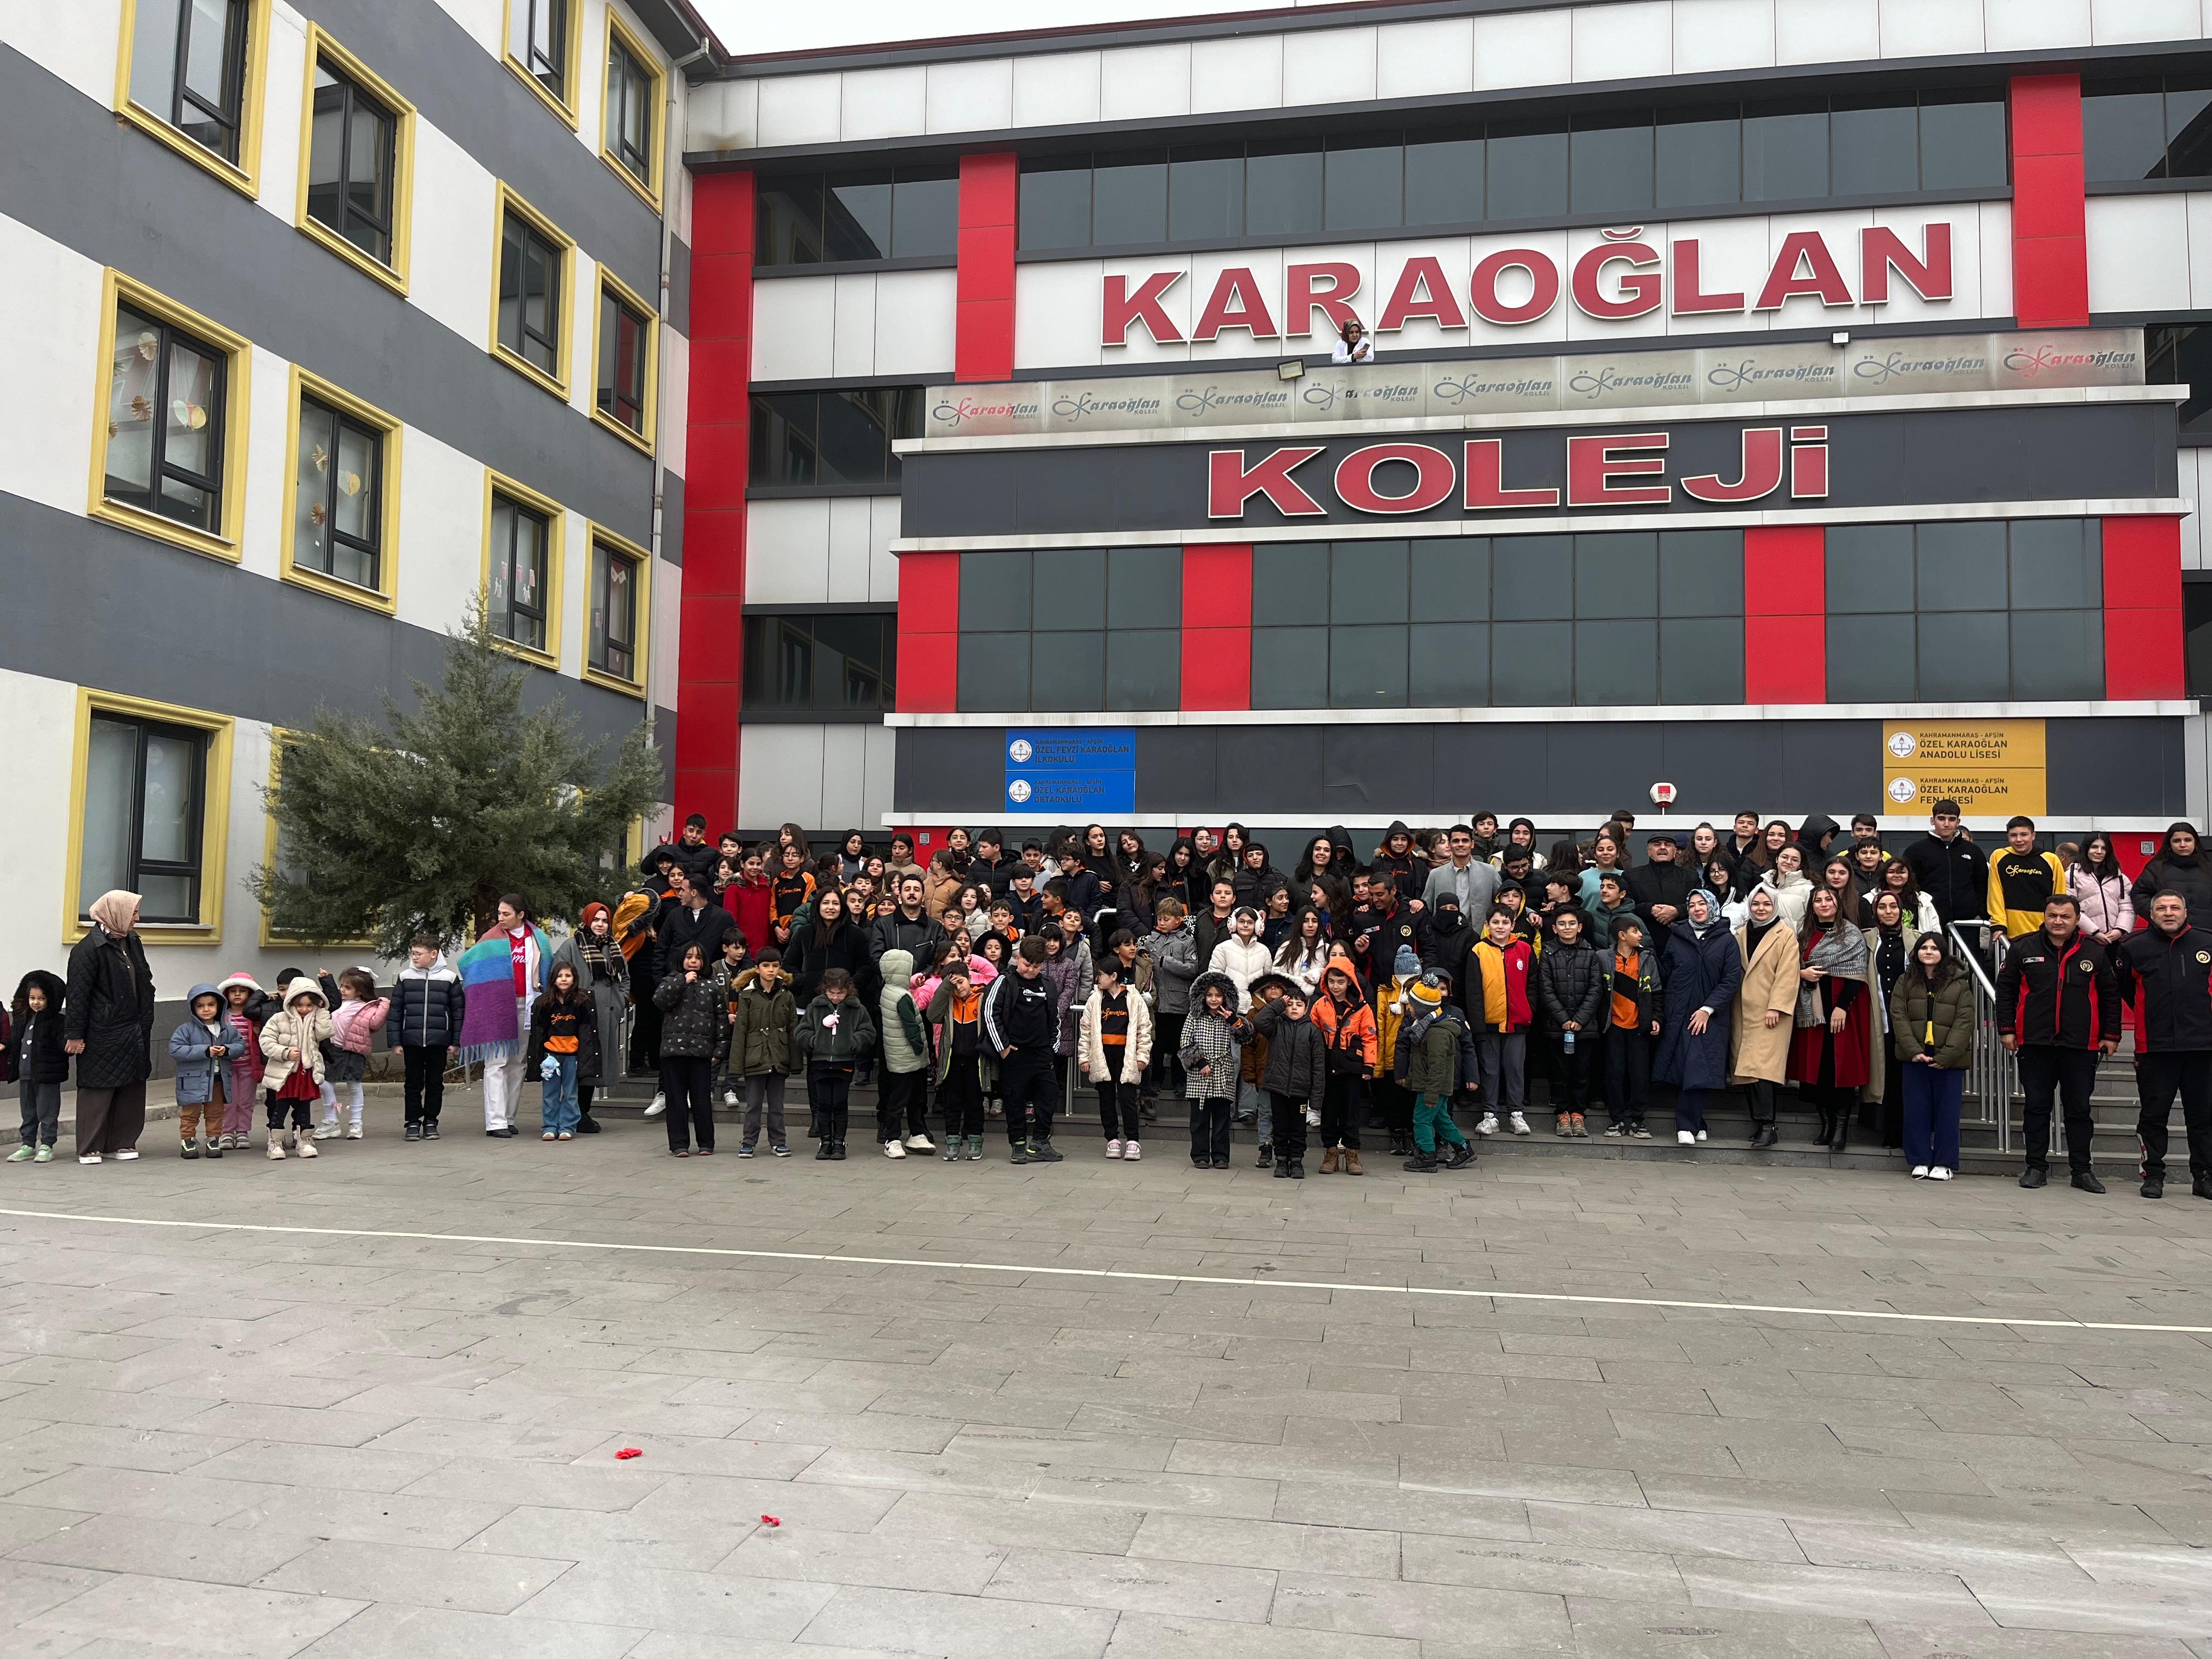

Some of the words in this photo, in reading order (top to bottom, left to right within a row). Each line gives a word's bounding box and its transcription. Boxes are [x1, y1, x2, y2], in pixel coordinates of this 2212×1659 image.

[1102, 222, 1954, 346] KARAOĞLAN
[1920, 738, 1944, 748] ÖZEL
[1948, 738, 2007, 748] KARAOĞLAN
[1035, 745, 1055, 753] ÖZEL
[1057, 745, 1079, 753] FEVZİ
[1081, 744, 1130, 753] KARAOĞLAN
[1970, 749, 2000, 758] LİSESİ
[1035, 785, 1054, 793] ÖZEL
[1057, 785, 1104, 793] KARAOĞLAN
[1920, 784, 1944, 793] ÖZEL
[1948, 784, 2008, 793] KARAOĞLAN
